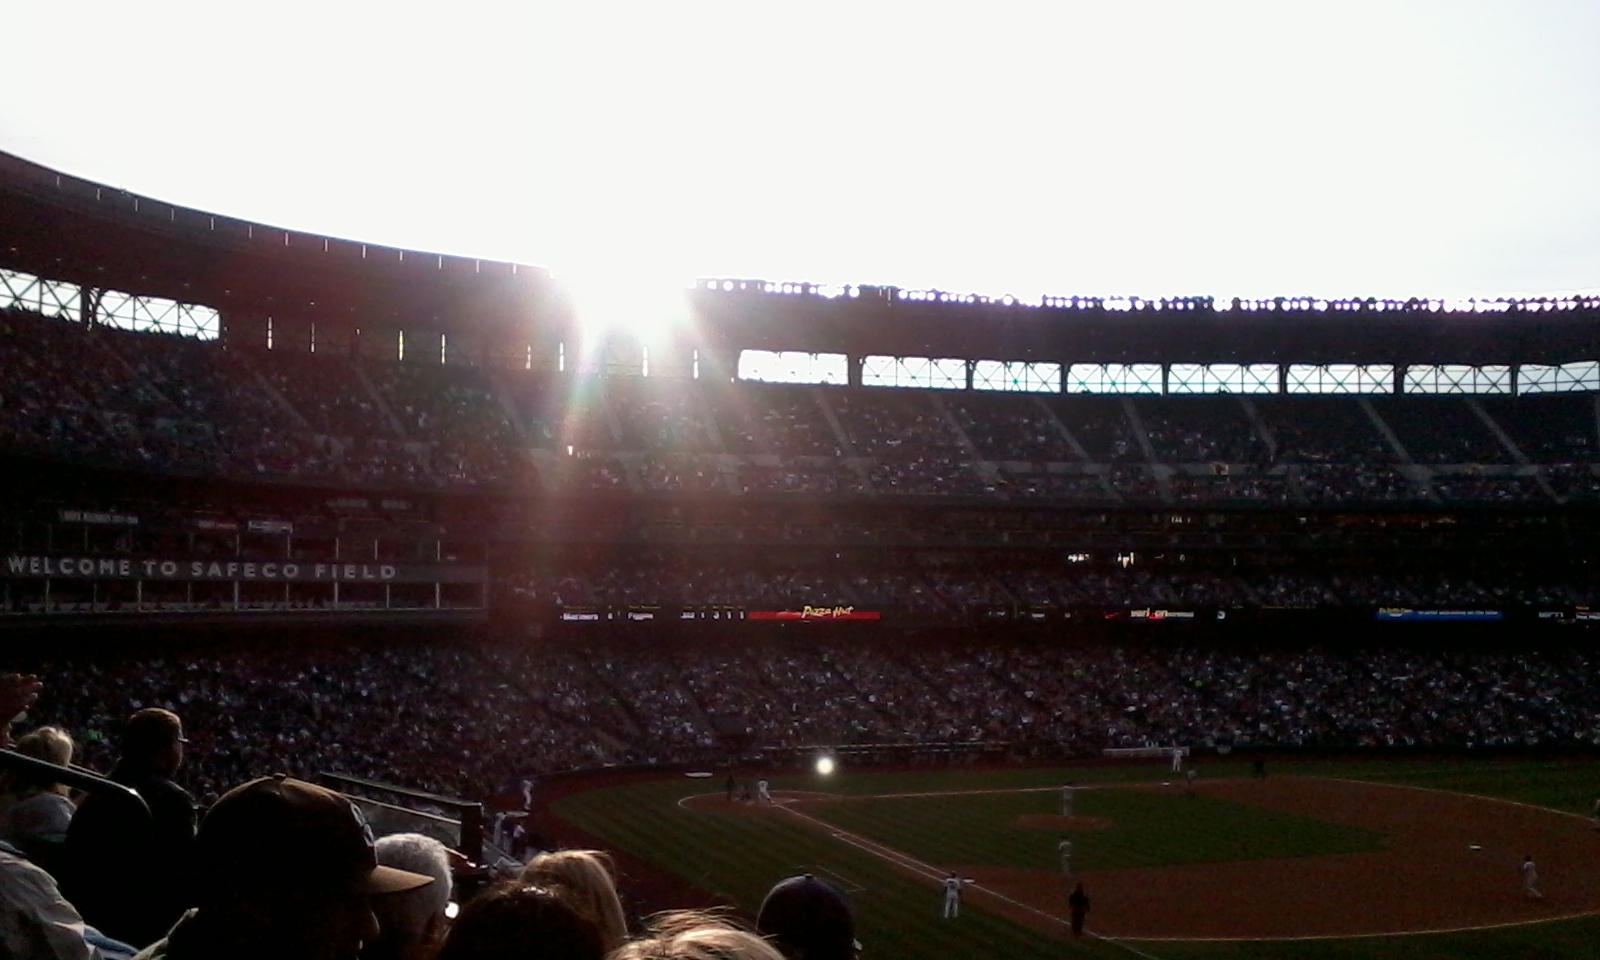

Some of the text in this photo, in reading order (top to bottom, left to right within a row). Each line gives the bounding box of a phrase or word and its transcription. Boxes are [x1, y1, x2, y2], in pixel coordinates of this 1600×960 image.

[8, 556, 396, 579] WELCOME TO SAFECO FIELD
[801, 605, 854, 618] Pizza Hut
